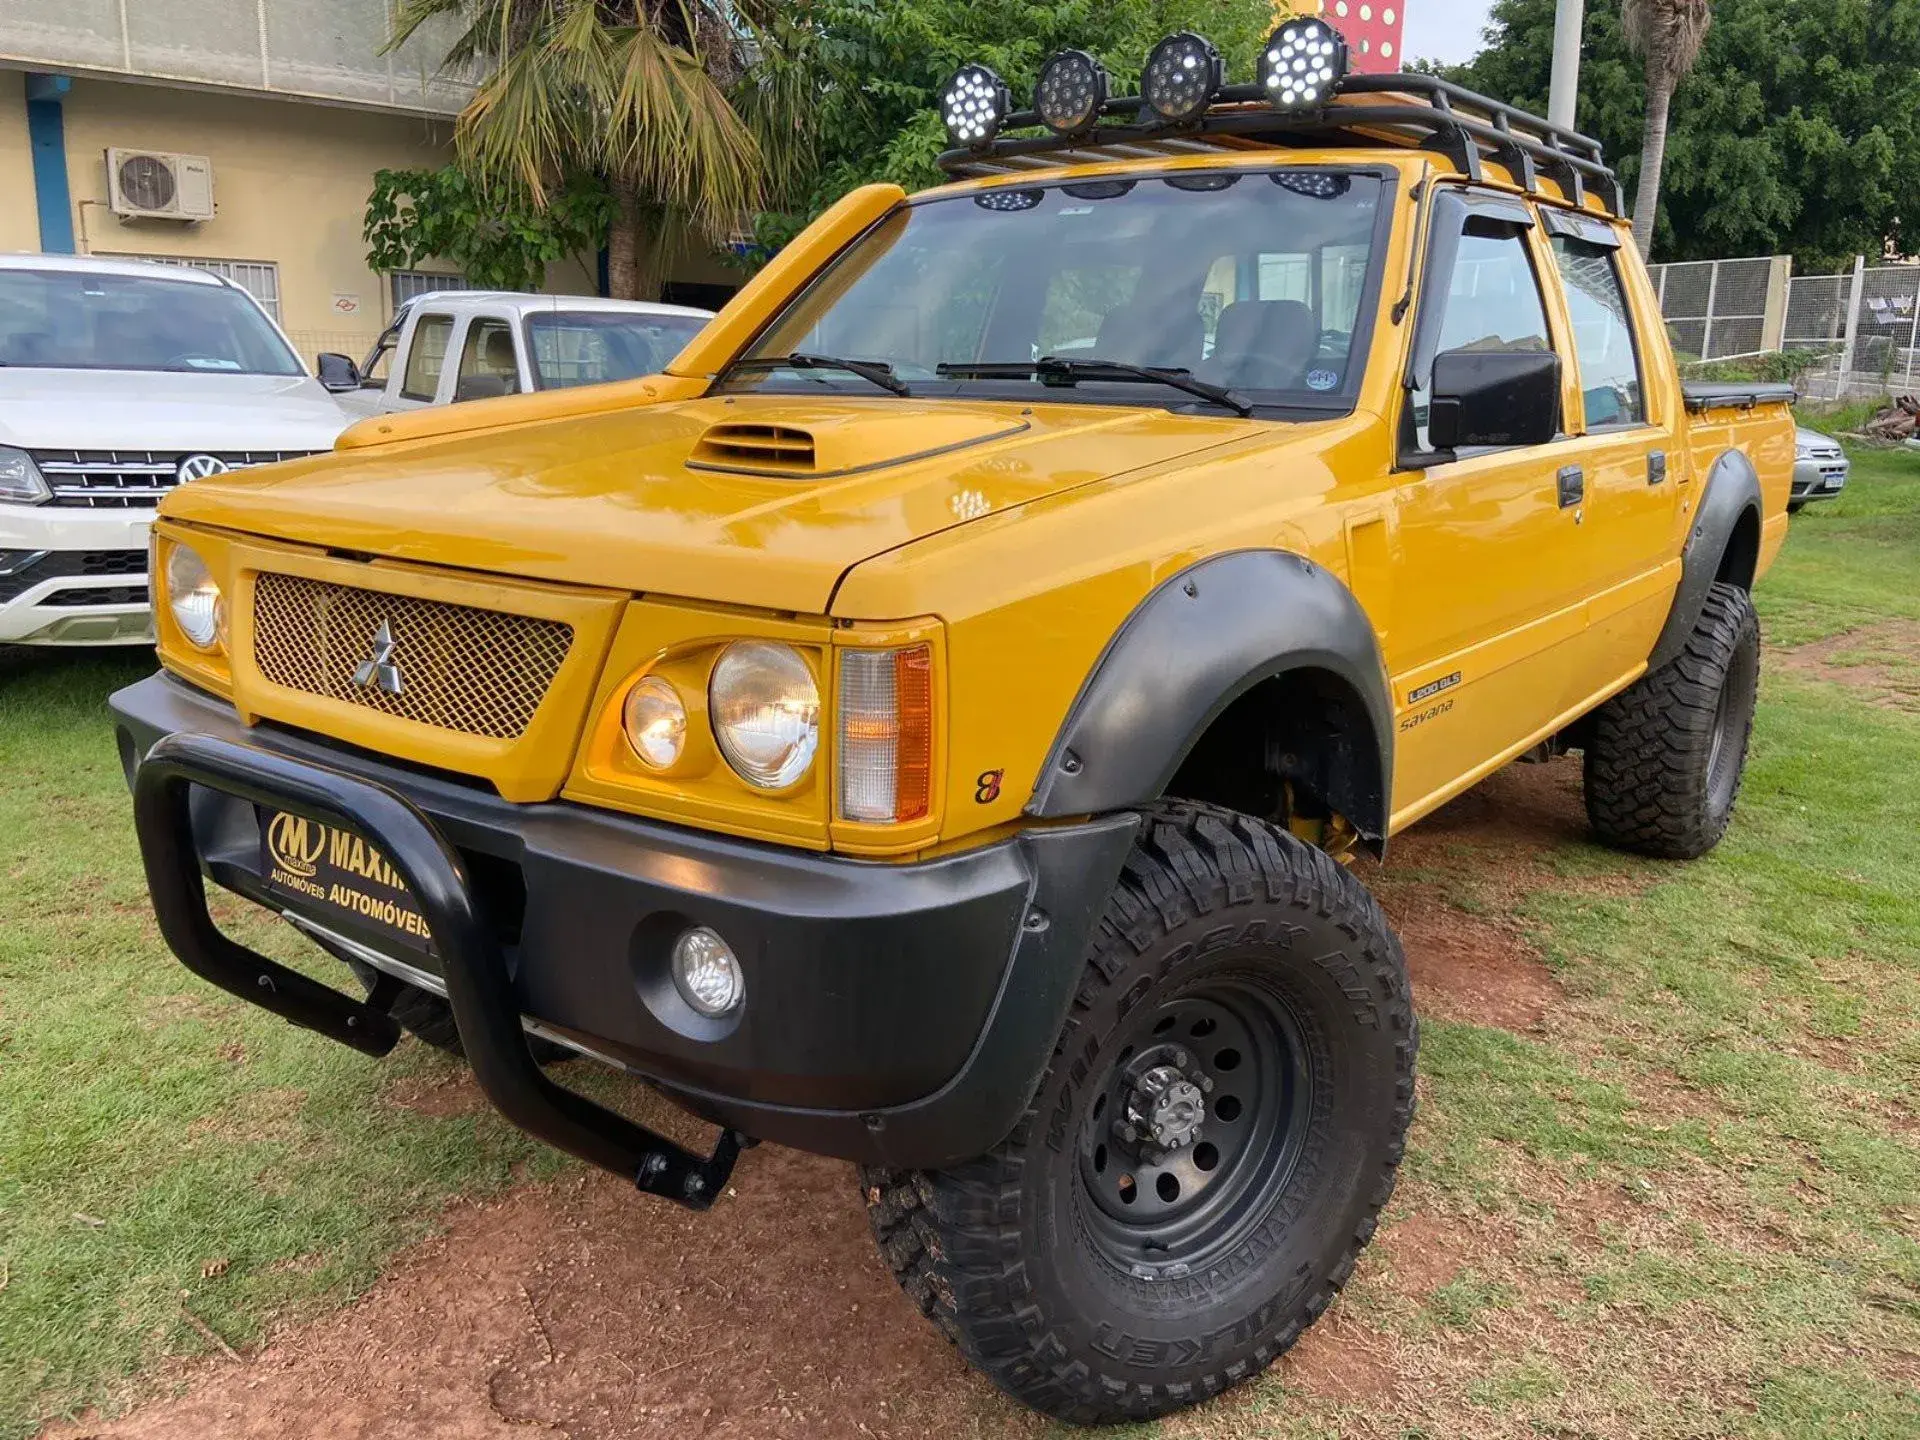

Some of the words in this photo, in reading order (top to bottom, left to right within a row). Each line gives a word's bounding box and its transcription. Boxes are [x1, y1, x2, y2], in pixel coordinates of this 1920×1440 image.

[1409, 681, 1438, 703] L200
[271, 868, 325, 900] AUTOMÓVEIS
[329, 883, 432, 939] AUTOMÓVEIS
